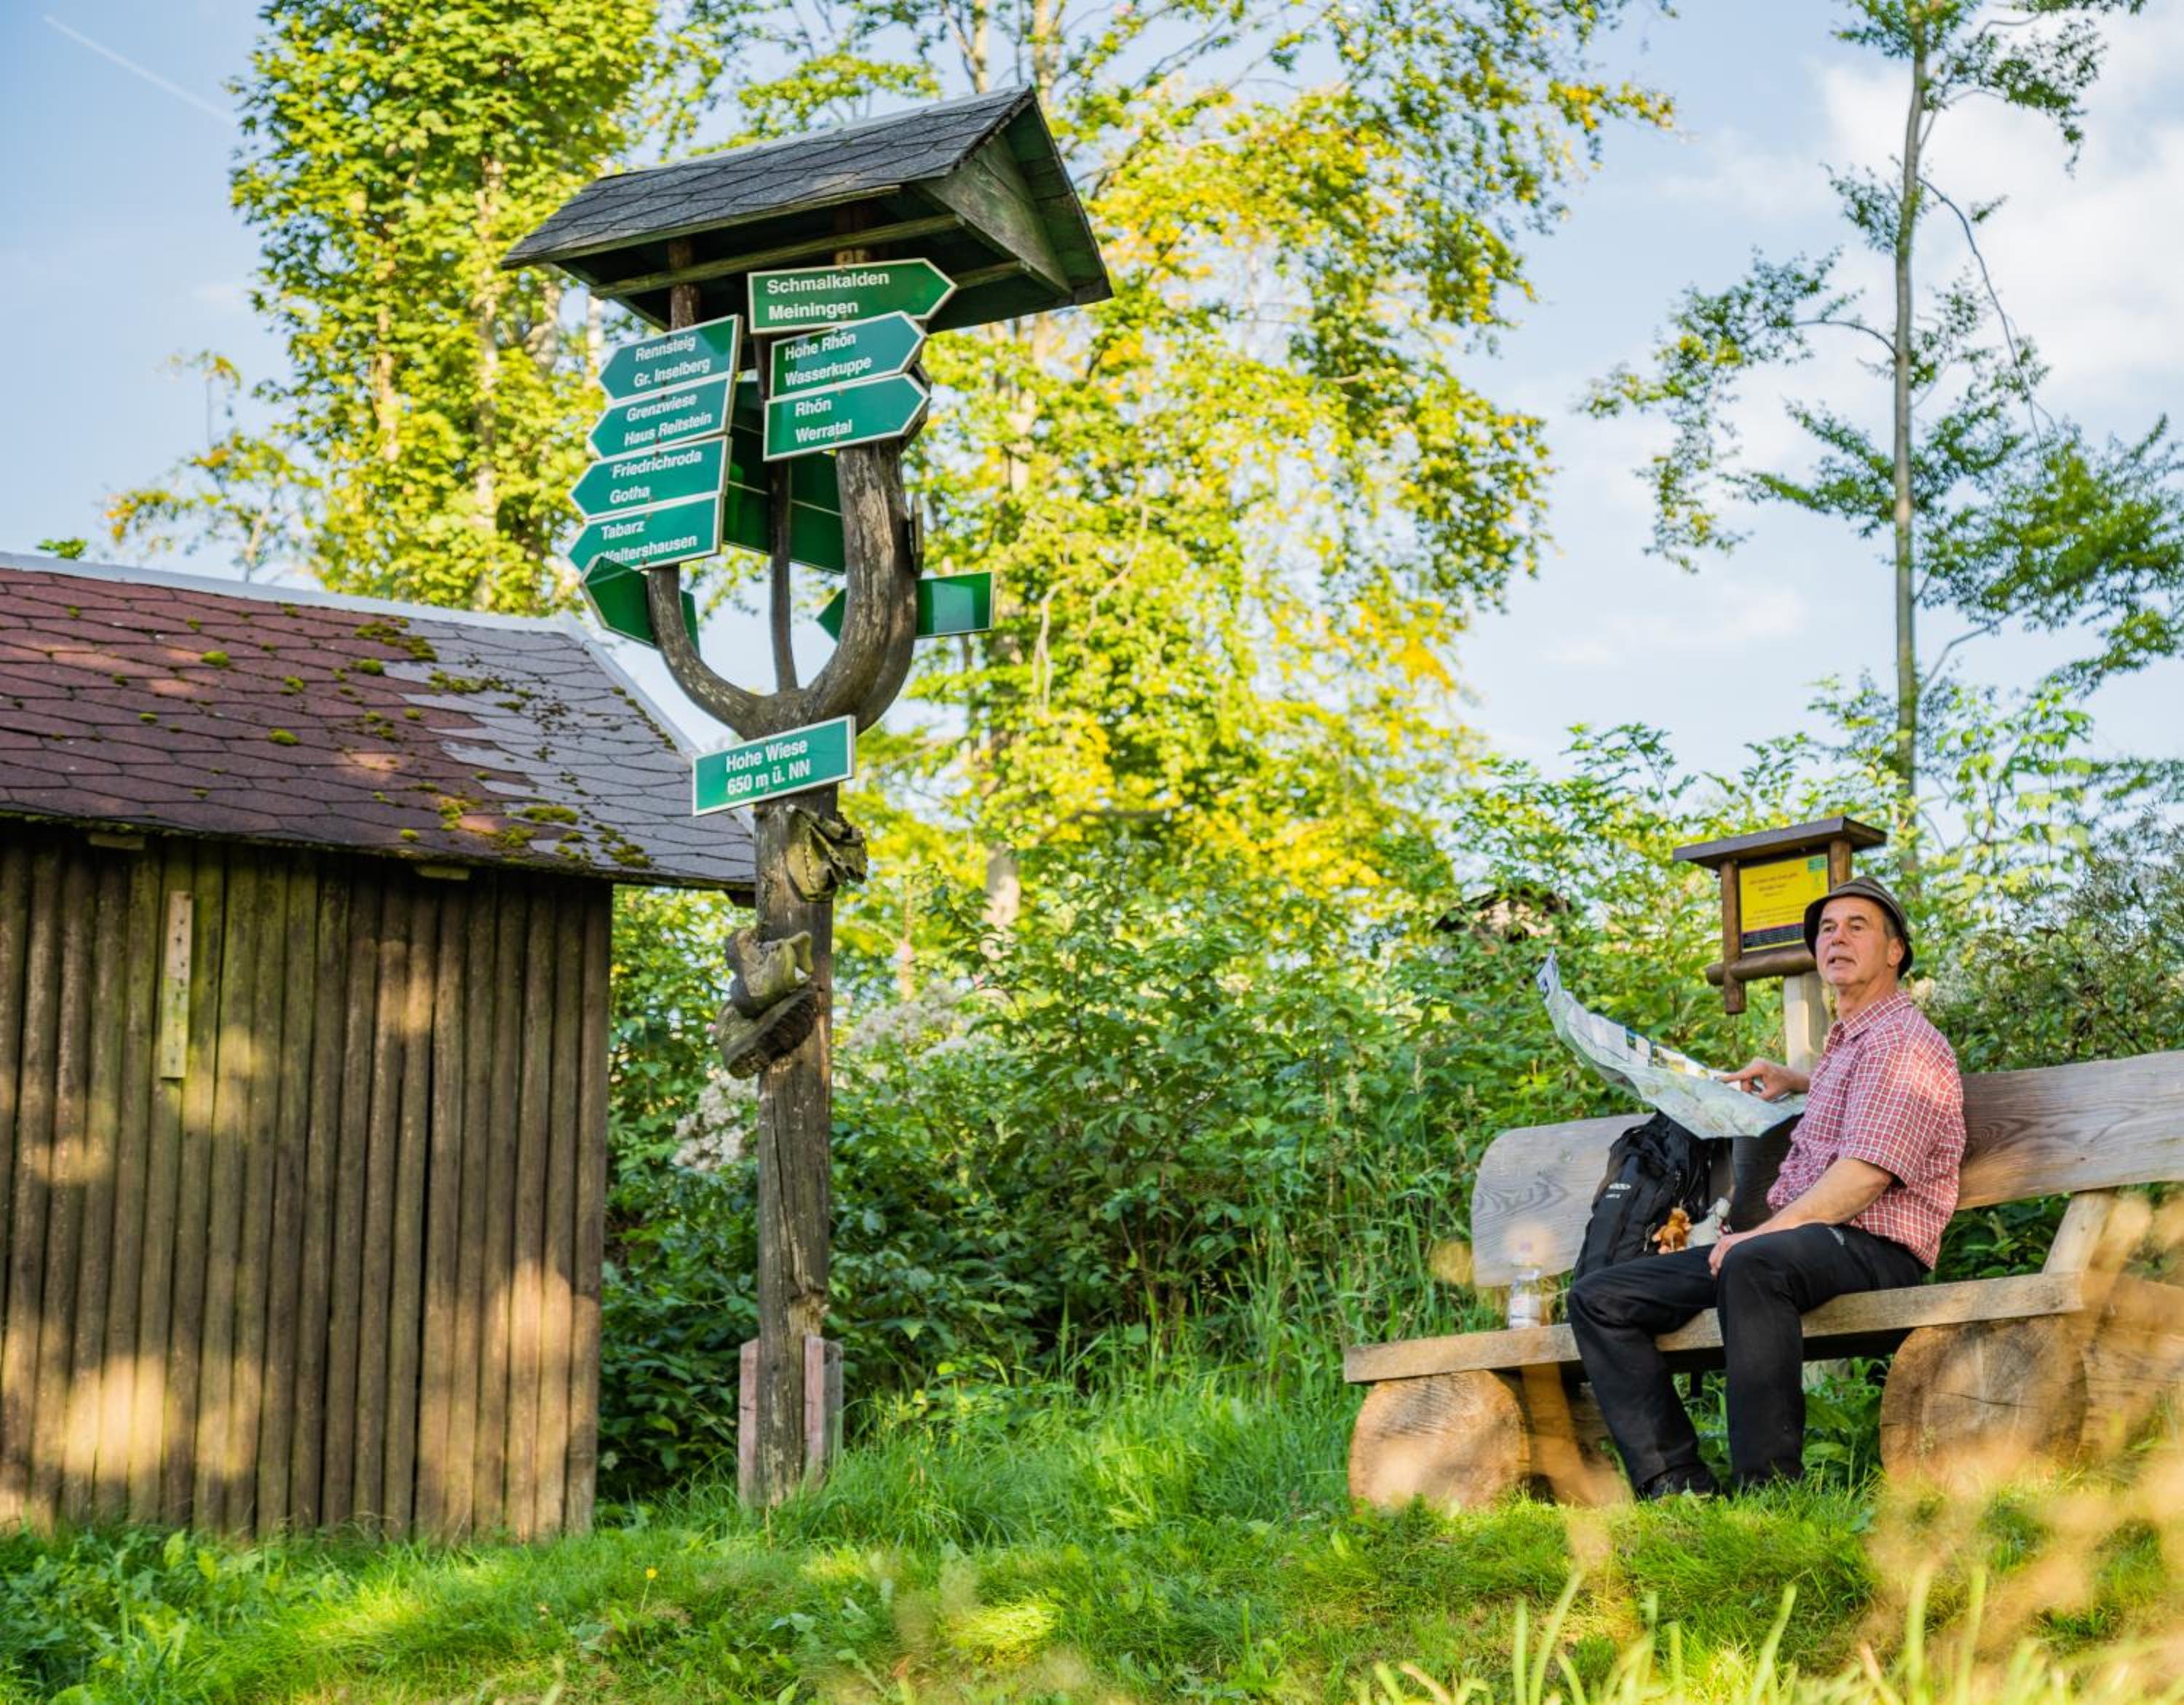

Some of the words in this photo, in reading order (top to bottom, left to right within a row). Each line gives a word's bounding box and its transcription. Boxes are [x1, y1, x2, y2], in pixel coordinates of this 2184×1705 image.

[767, 272, 890, 294] Schmalkalden
[768, 301, 858, 321] Meiningen
[636, 336, 696, 362] Rennsteig
[785, 344, 818, 361] Hohe
[822, 332, 856, 352] Rhön
[634, 372, 652, 387] Gr.
[654, 358, 711, 383] Inselberg
[785, 357, 872, 387] Wasserkuppe
[627, 394, 697, 422] Grenzwiese
[795, 397, 832, 417] Rhön
[624, 428, 655, 446] Haus
[796, 419, 852, 443] Werratal
[612, 450, 703, 478] Friedrichroda
[609, 486, 650, 505] Gotha
[601, 521, 645, 540] Tabarz
[726, 751, 762, 772] Hohe
[765, 739, 808, 762] Wiese
[727, 775, 753, 795] 650
[755, 774, 769, 787] m
[772, 766, 785, 784] ü.
[788, 759, 810, 780] NN
